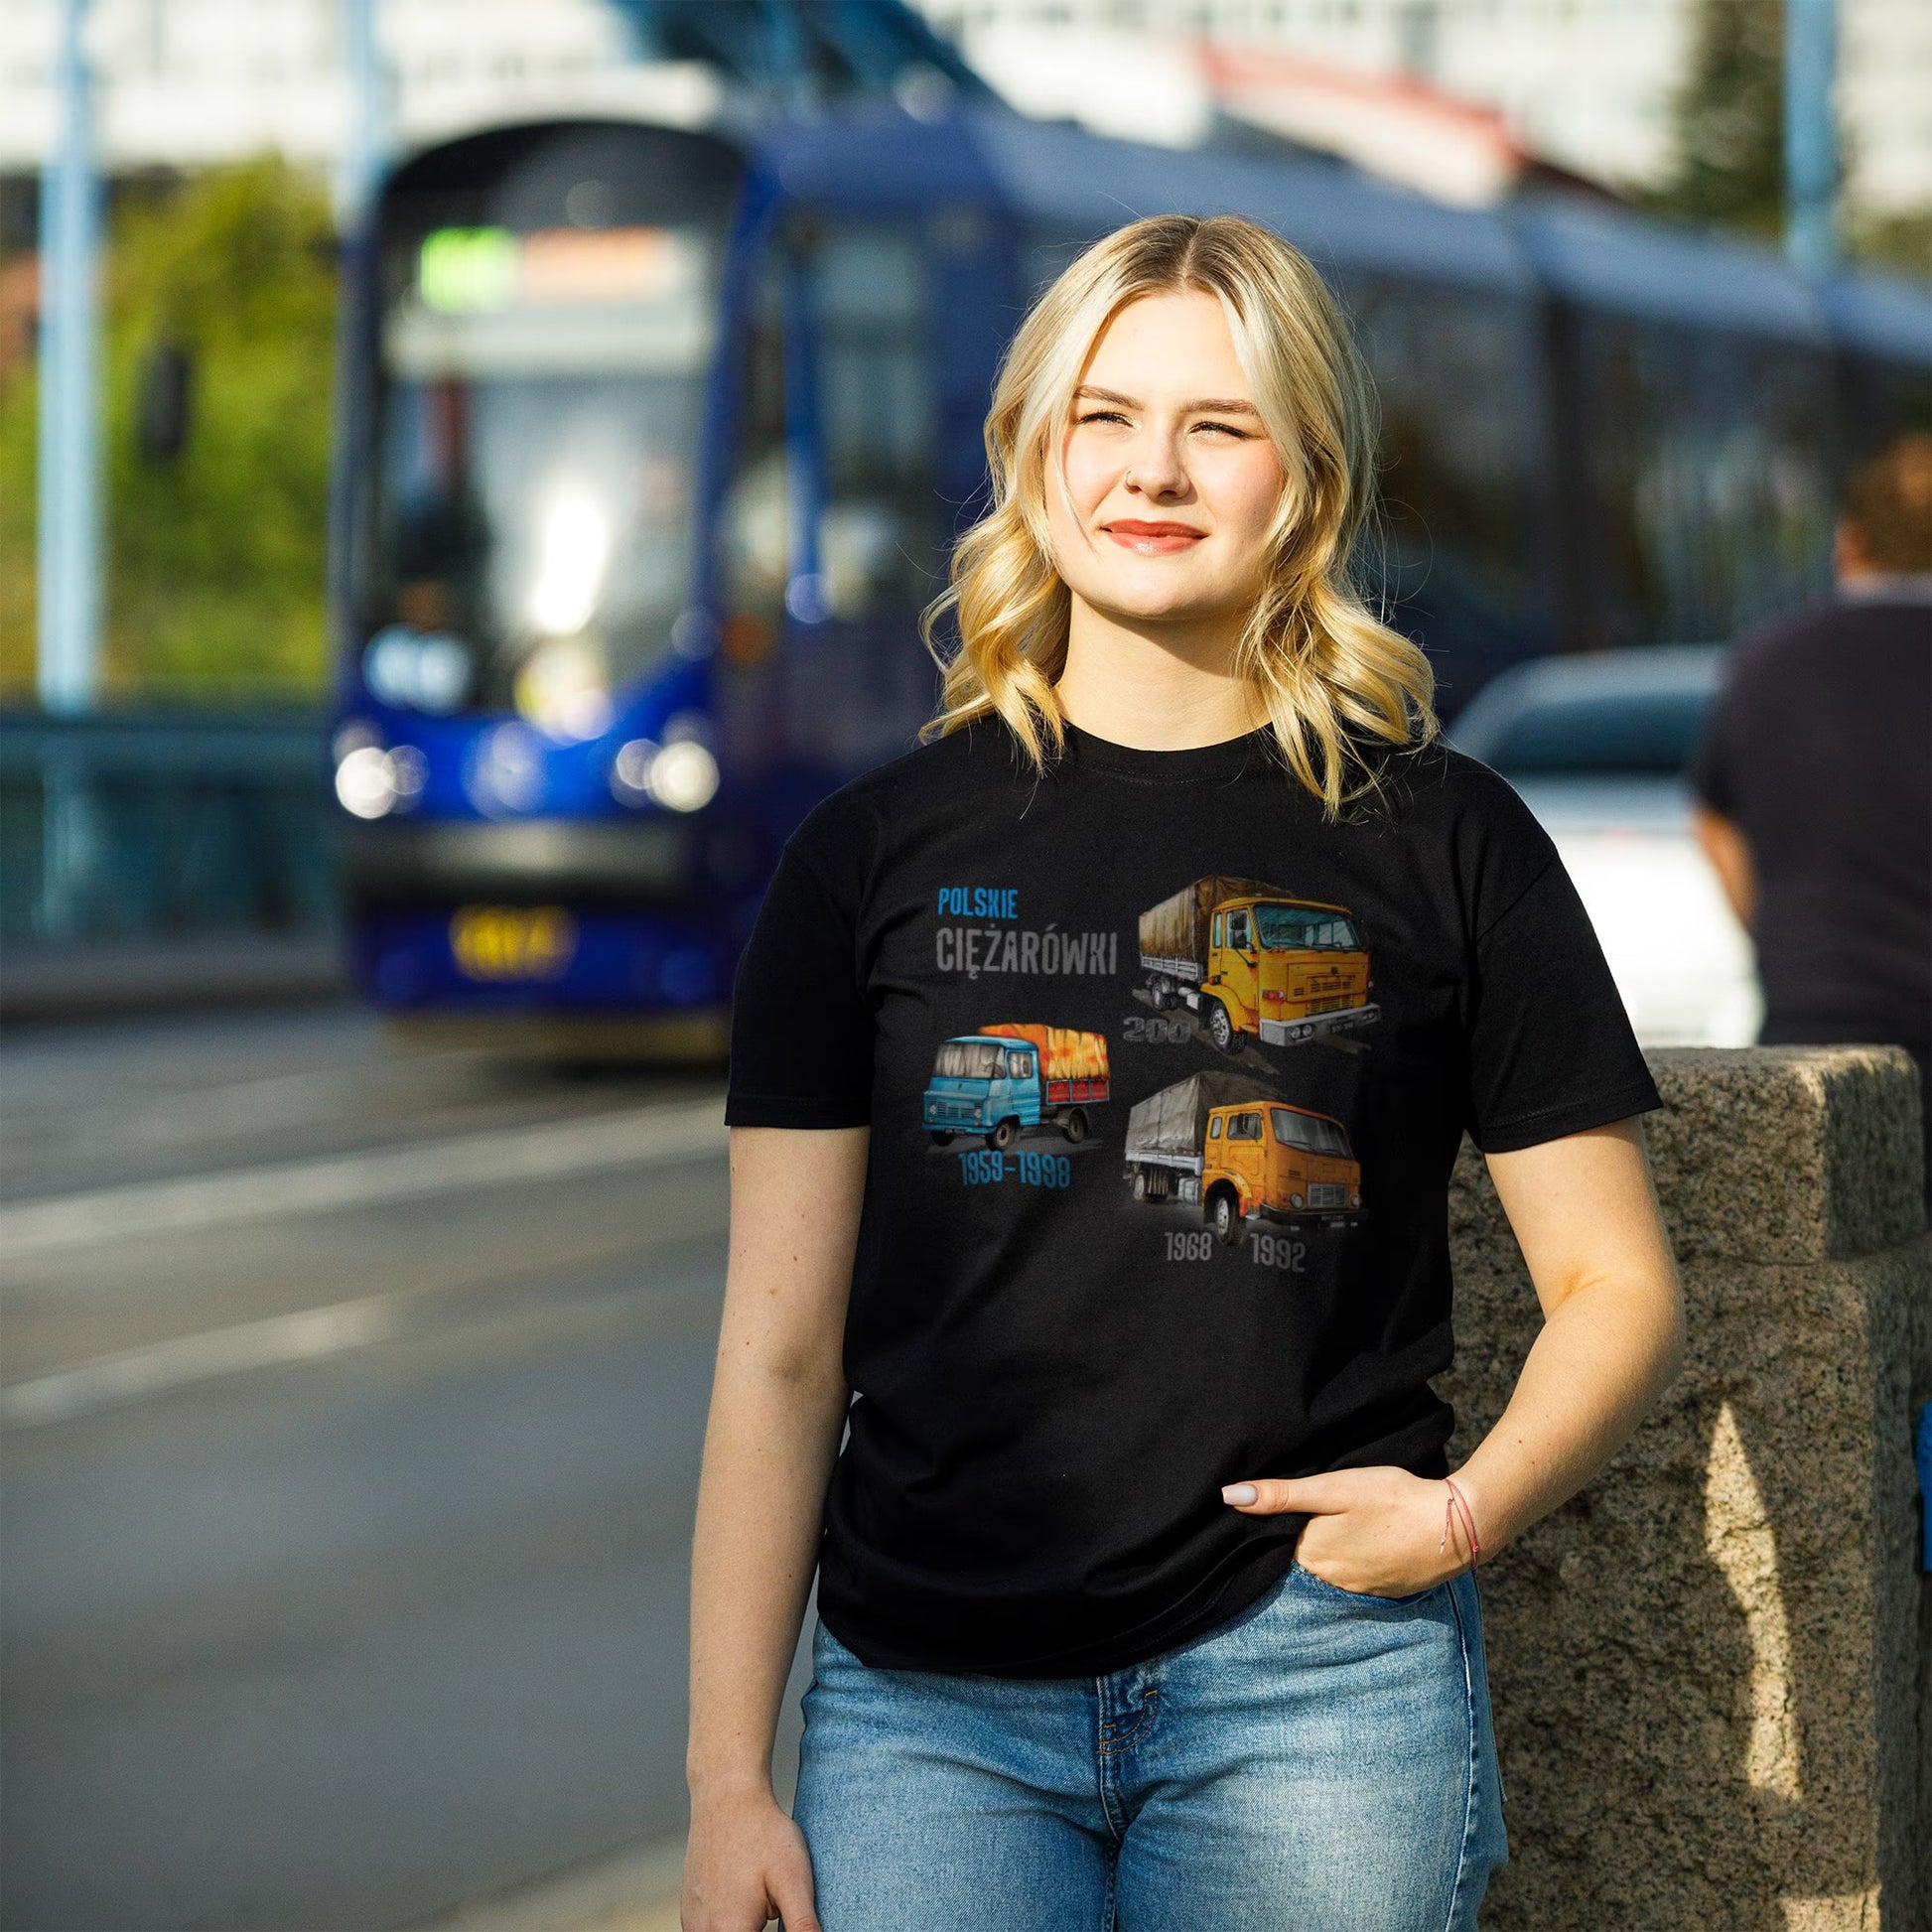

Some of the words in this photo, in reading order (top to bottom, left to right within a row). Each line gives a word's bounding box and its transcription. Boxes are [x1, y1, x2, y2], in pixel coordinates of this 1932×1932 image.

[937, 886, 1020, 920] POLSKIE
[935, 923, 1119, 980] CIĘŻARÓWKI
[1123, 1016, 1191, 1043] 200
[958, 1150, 1071, 1189] 1959-1998
[1164, 1231, 1212, 1262] 1968
[1249, 1232, 1307, 1273] 1992
